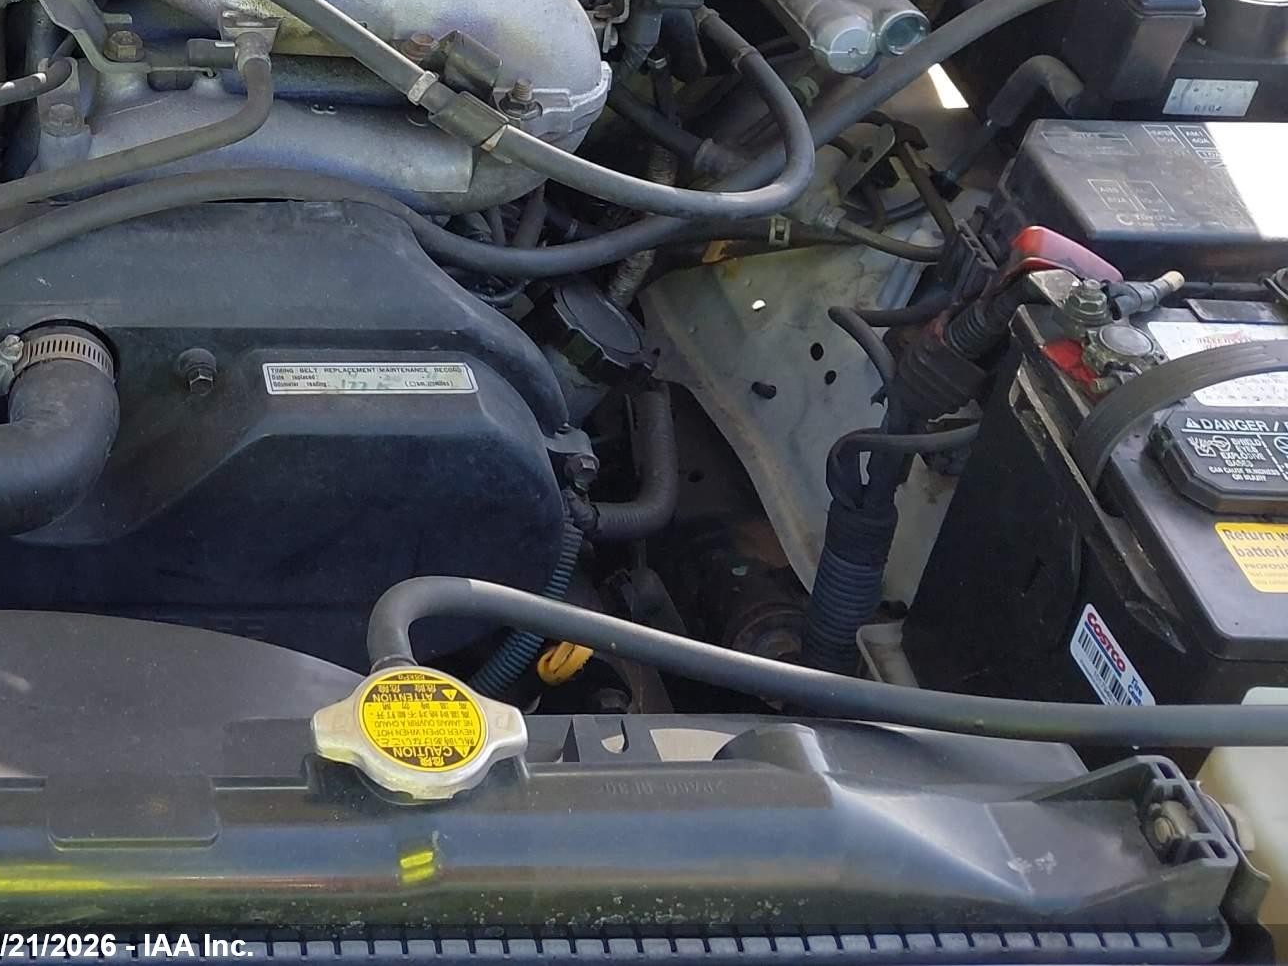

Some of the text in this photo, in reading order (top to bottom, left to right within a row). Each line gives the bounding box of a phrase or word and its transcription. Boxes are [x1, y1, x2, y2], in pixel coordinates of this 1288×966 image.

[1199, 418, 1269, 432] DANGER
[1230, 437, 1261, 447] SHIELD
[1219, 451, 1266, 461] EXPLOSIVE
[1222, 529, 1276, 541] Return
[1087, 612, 1126, 673] COSTCO
[372, 692, 434, 702] ATTENTION
[395, 728, 420, 736] WHEN
[422, 728, 445, 736] OPEN
[447, 728, 475, 736] NEVER
[393, 747, 453, 757] CAUTION
